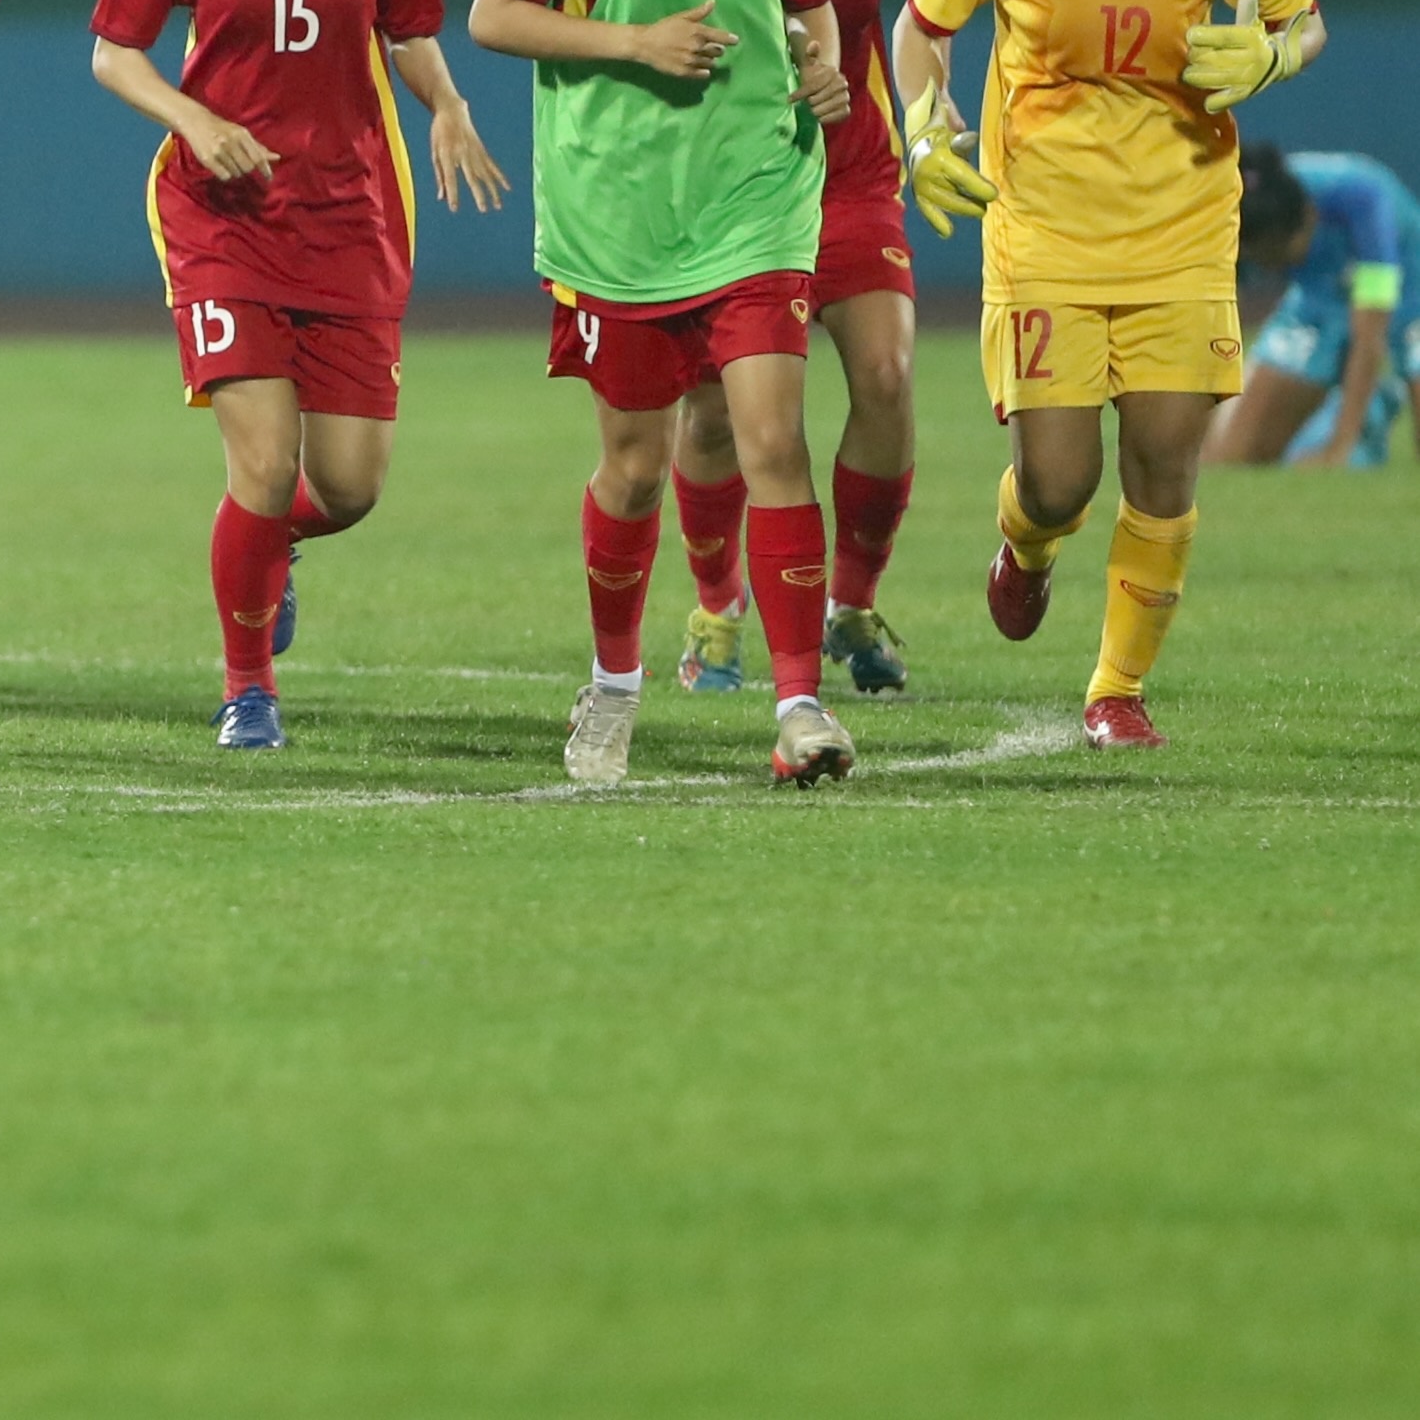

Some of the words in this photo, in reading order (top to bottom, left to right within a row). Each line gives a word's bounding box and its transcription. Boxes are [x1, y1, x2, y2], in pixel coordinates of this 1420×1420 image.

[1100, 6, 1152, 76] 12
[192, 300, 234, 356] 15
[1010, 309, 1053, 380] 12
